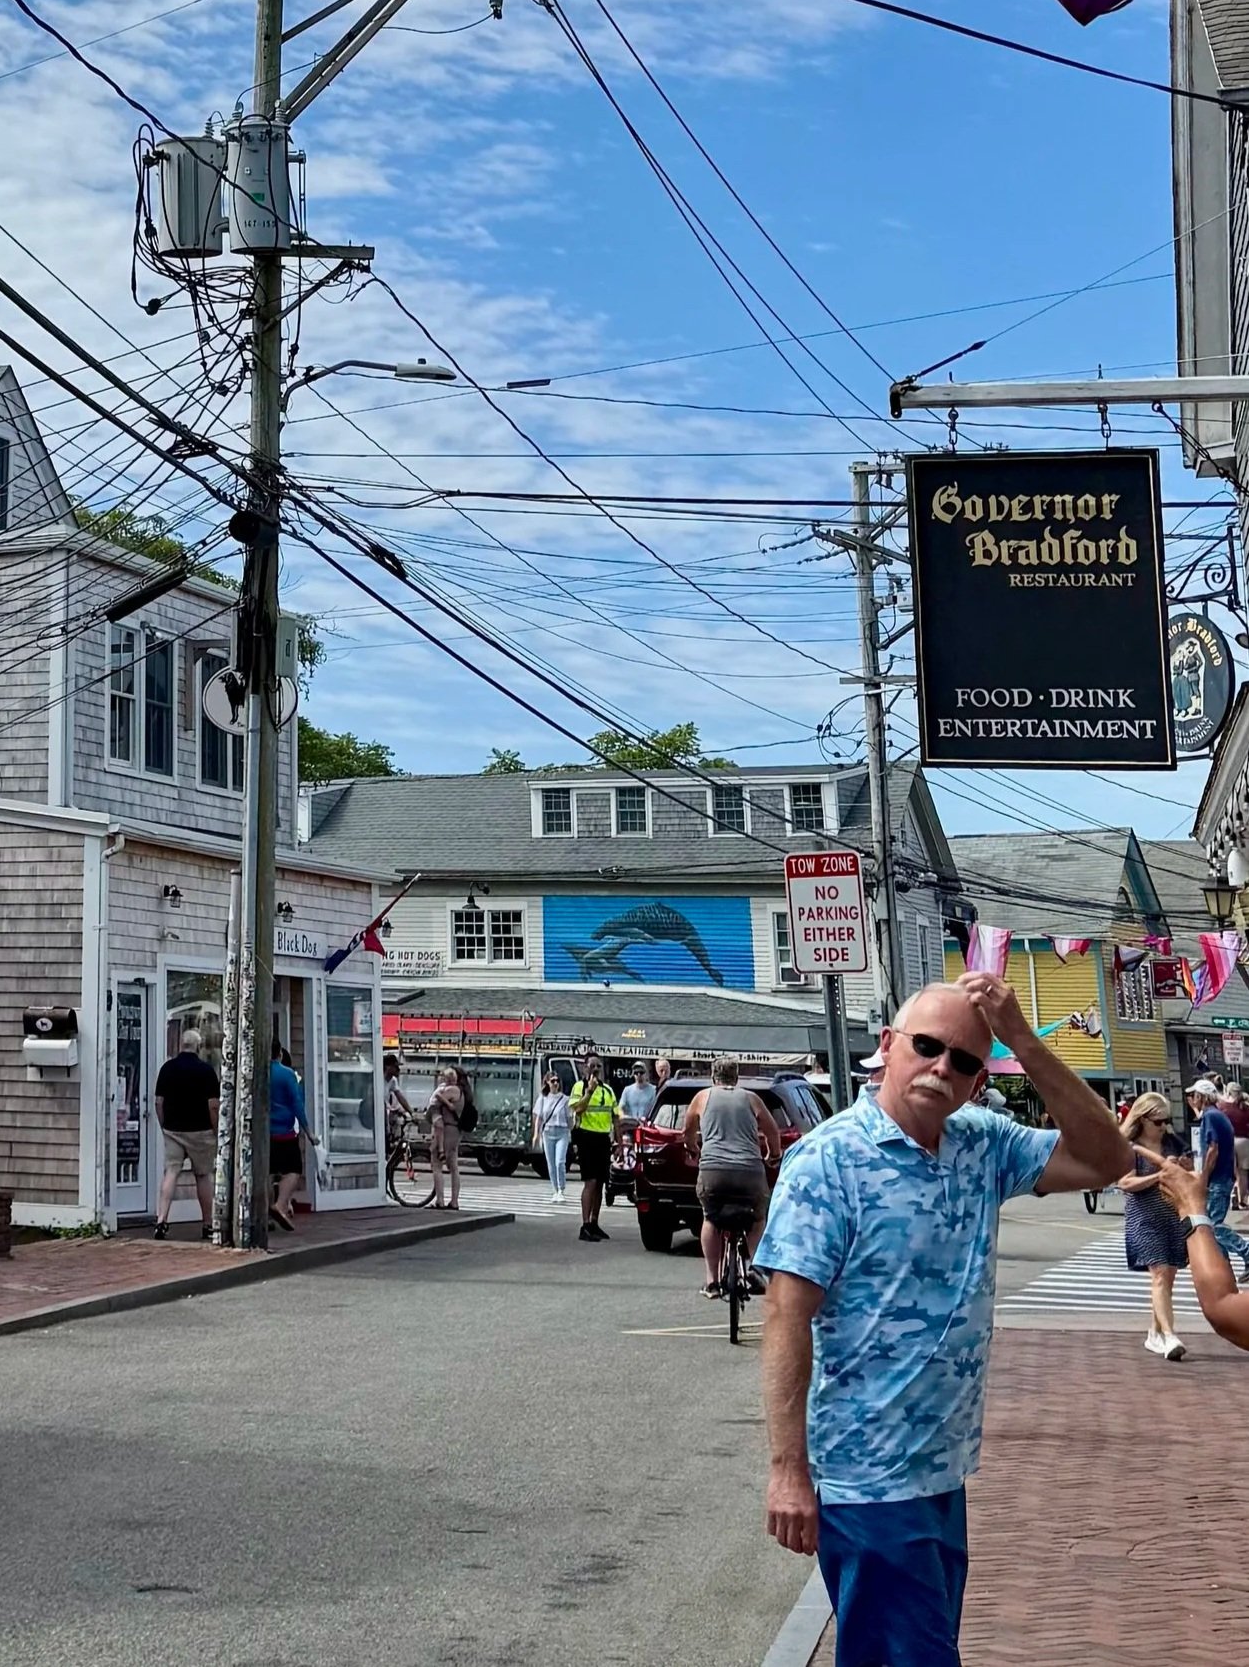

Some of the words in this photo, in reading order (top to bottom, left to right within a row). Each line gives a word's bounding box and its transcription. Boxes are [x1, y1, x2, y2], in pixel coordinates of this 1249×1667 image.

[931, 481, 1121, 524] Governor
[965, 525, 1137, 567] Bradford
[1008, 573, 1137, 587] RESTAURANT
[954, 688, 1033, 708] FOOD
[1048, 688, 1136, 709] DRINK
[937, 718, 1157, 739] ENTERTAINMENT
[789, 857, 816, 874] TOW
[820, 856, 855, 873] ZONE
[814, 885, 839, 901] NO
[798, 906, 859, 921] PARKING
[803, 927, 856, 942] EITHER
[277, 931, 300, 953] Black
[301, 934, 317, 957] Dog
[397, 951, 414, 960] HOT
[417, 951, 441, 961] DOGS
[813, 947, 849, 962] SIDE
